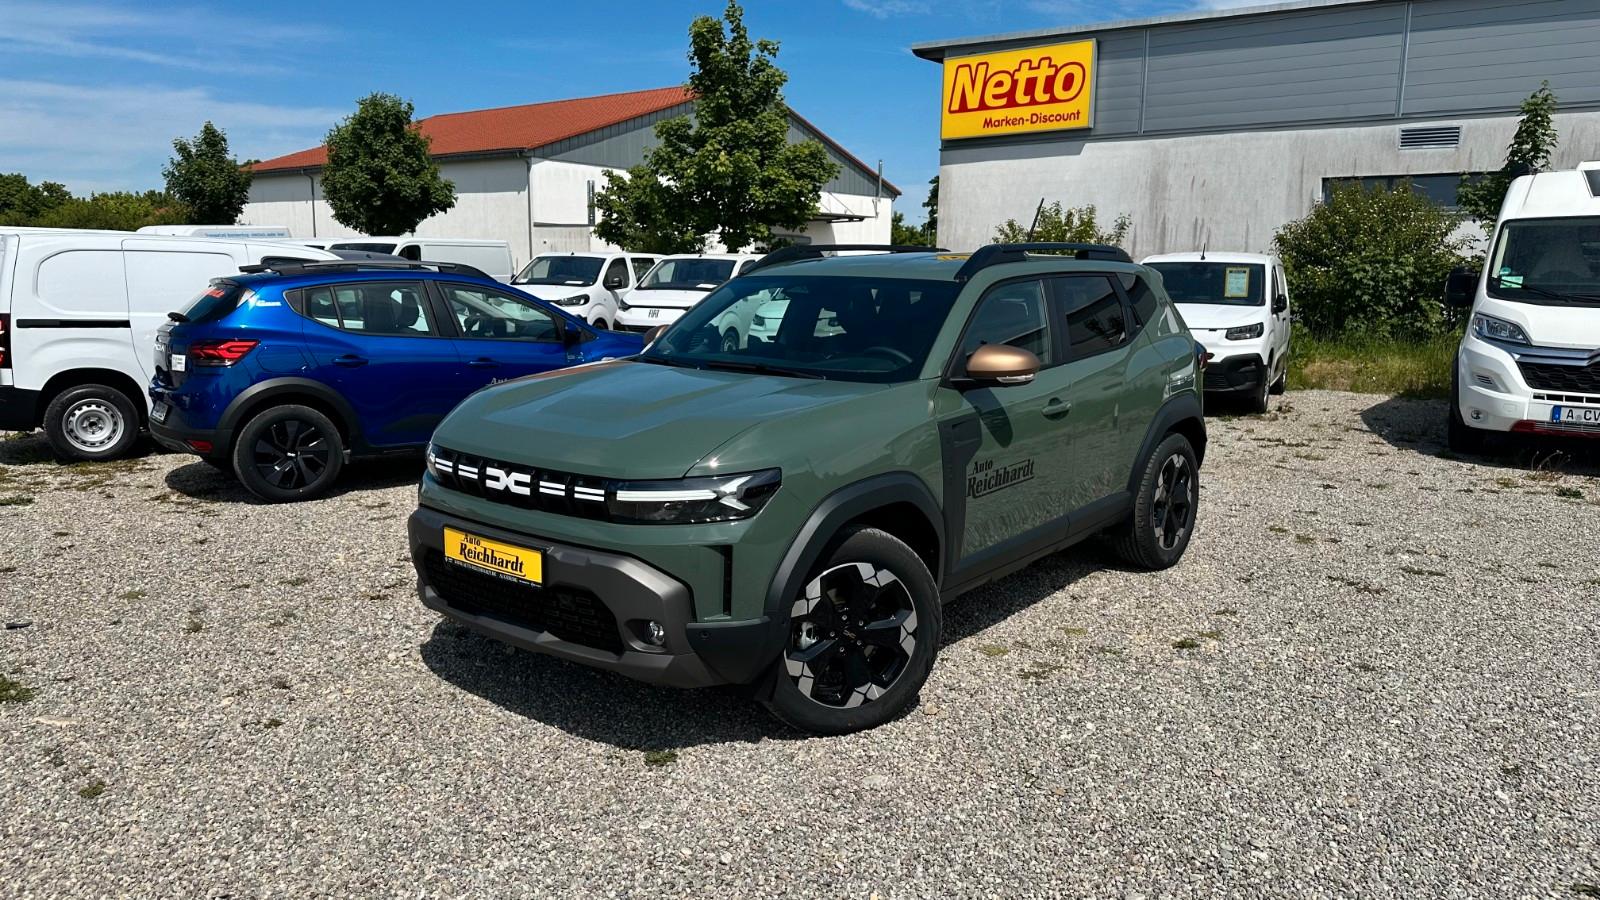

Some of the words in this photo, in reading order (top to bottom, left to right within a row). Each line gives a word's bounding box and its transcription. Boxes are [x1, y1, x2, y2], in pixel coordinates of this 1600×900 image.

[948, 56, 1086, 113] Netto
[983, 109, 1081, 128] Marken-Discount
[648, 309, 660, 319] FIAT
[1566, 409, 1574, 420] A
[972, 459, 994, 475] Auto
[966, 459, 1035, 499] Reichhardt
[463, 534, 481, 547] Auto
[459, 542, 527, 577] Reichhardt
